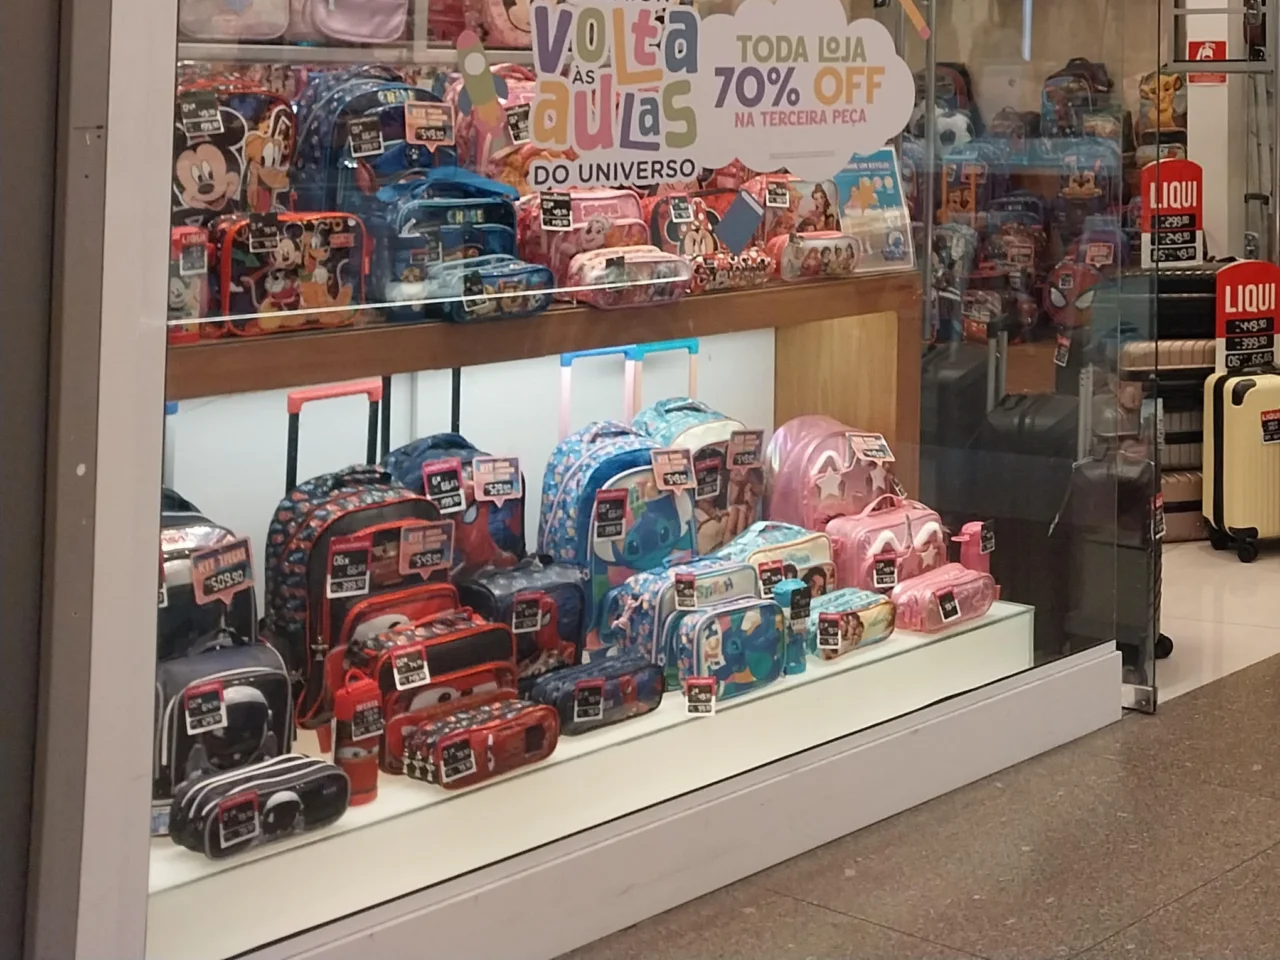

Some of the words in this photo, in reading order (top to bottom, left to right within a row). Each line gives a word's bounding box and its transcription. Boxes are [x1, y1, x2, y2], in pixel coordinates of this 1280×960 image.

[736, 35, 809, 63] TODA
[818, 35, 867, 63] LOJA
[572, 64, 595, 85] ÀS
[714, 66, 800, 108] 70%
[813, 66, 886, 106] OFF
[734, 111, 755, 128] NA
[760, 109, 828, 128] TERCEIRA
[832, 109, 867, 128] PEÇA
[534, 164, 569, 186] DO
[578, 158, 696, 184] UNIVERSO
[1150, 181, 1197, 209] LIQUI
[1225, 283, 1276, 313] LIQUI
